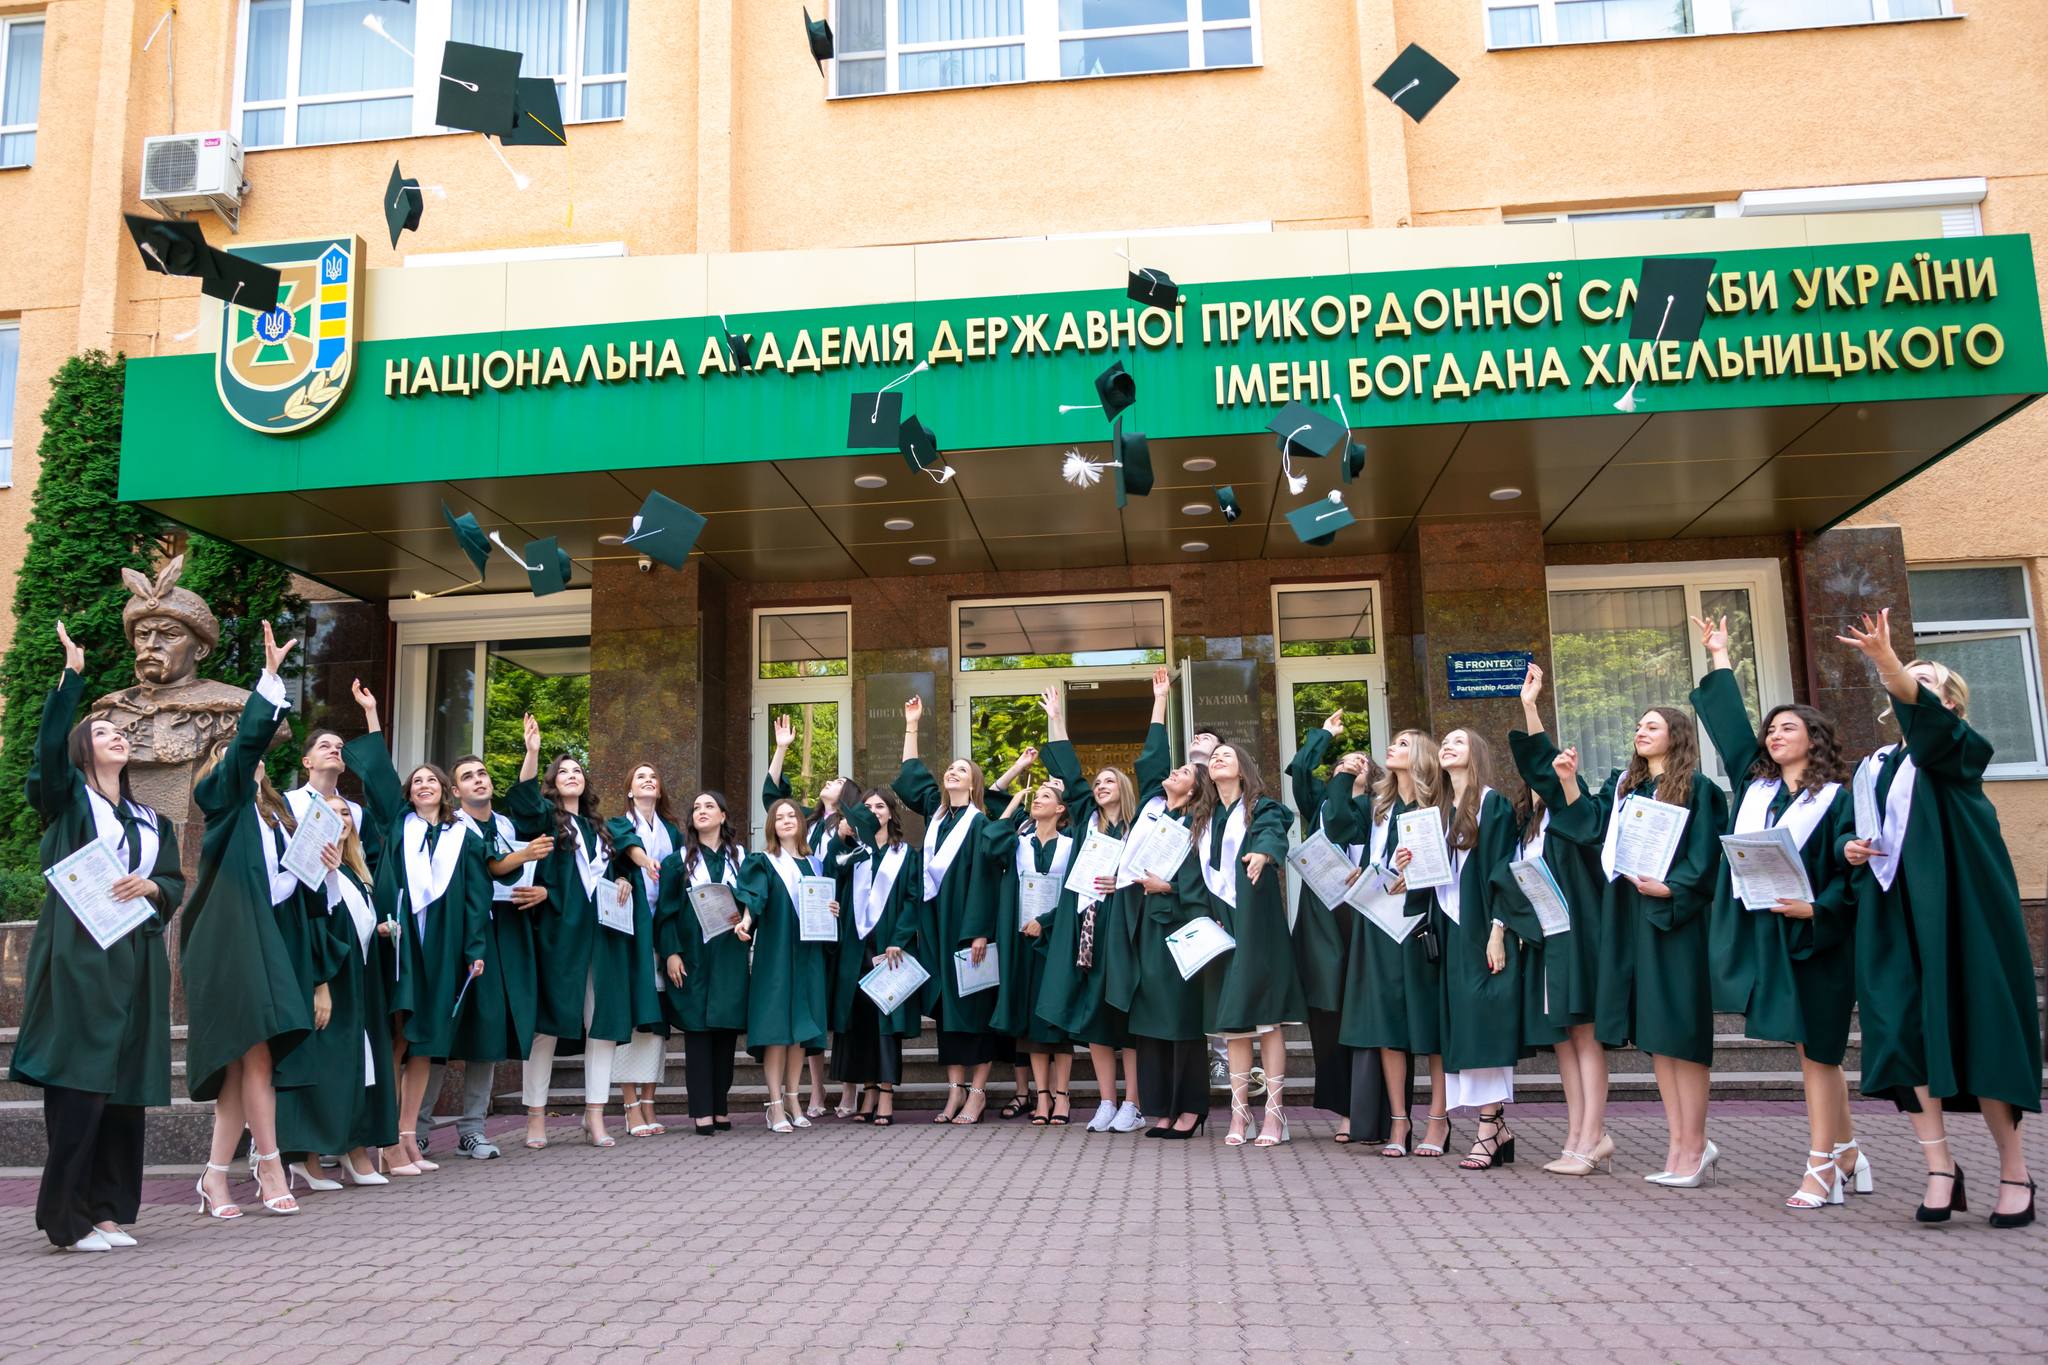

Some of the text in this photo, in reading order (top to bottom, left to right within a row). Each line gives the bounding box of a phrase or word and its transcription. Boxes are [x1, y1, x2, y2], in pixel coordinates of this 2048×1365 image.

[385, 339, 684, 396] НАЦІОНАЛЬНА
[929, 295, 1186, 364] ДЕРЖАВНОЇ
[1202, 273, 1563, 342] ПРИКОРДОННОЇ
[1579, 271, 1778, 320] СЛБИ
[1794, 253, 1998, 309] УКРАЇНИ
[1216, 323, 2005, 405] ІМЕНІ БОГДАНА ХМЕЛЬНИЦЬКОГО
[1465, 660, 1512, 668] FRONTEX
[1456, 684, 1495, 692] Partnership
